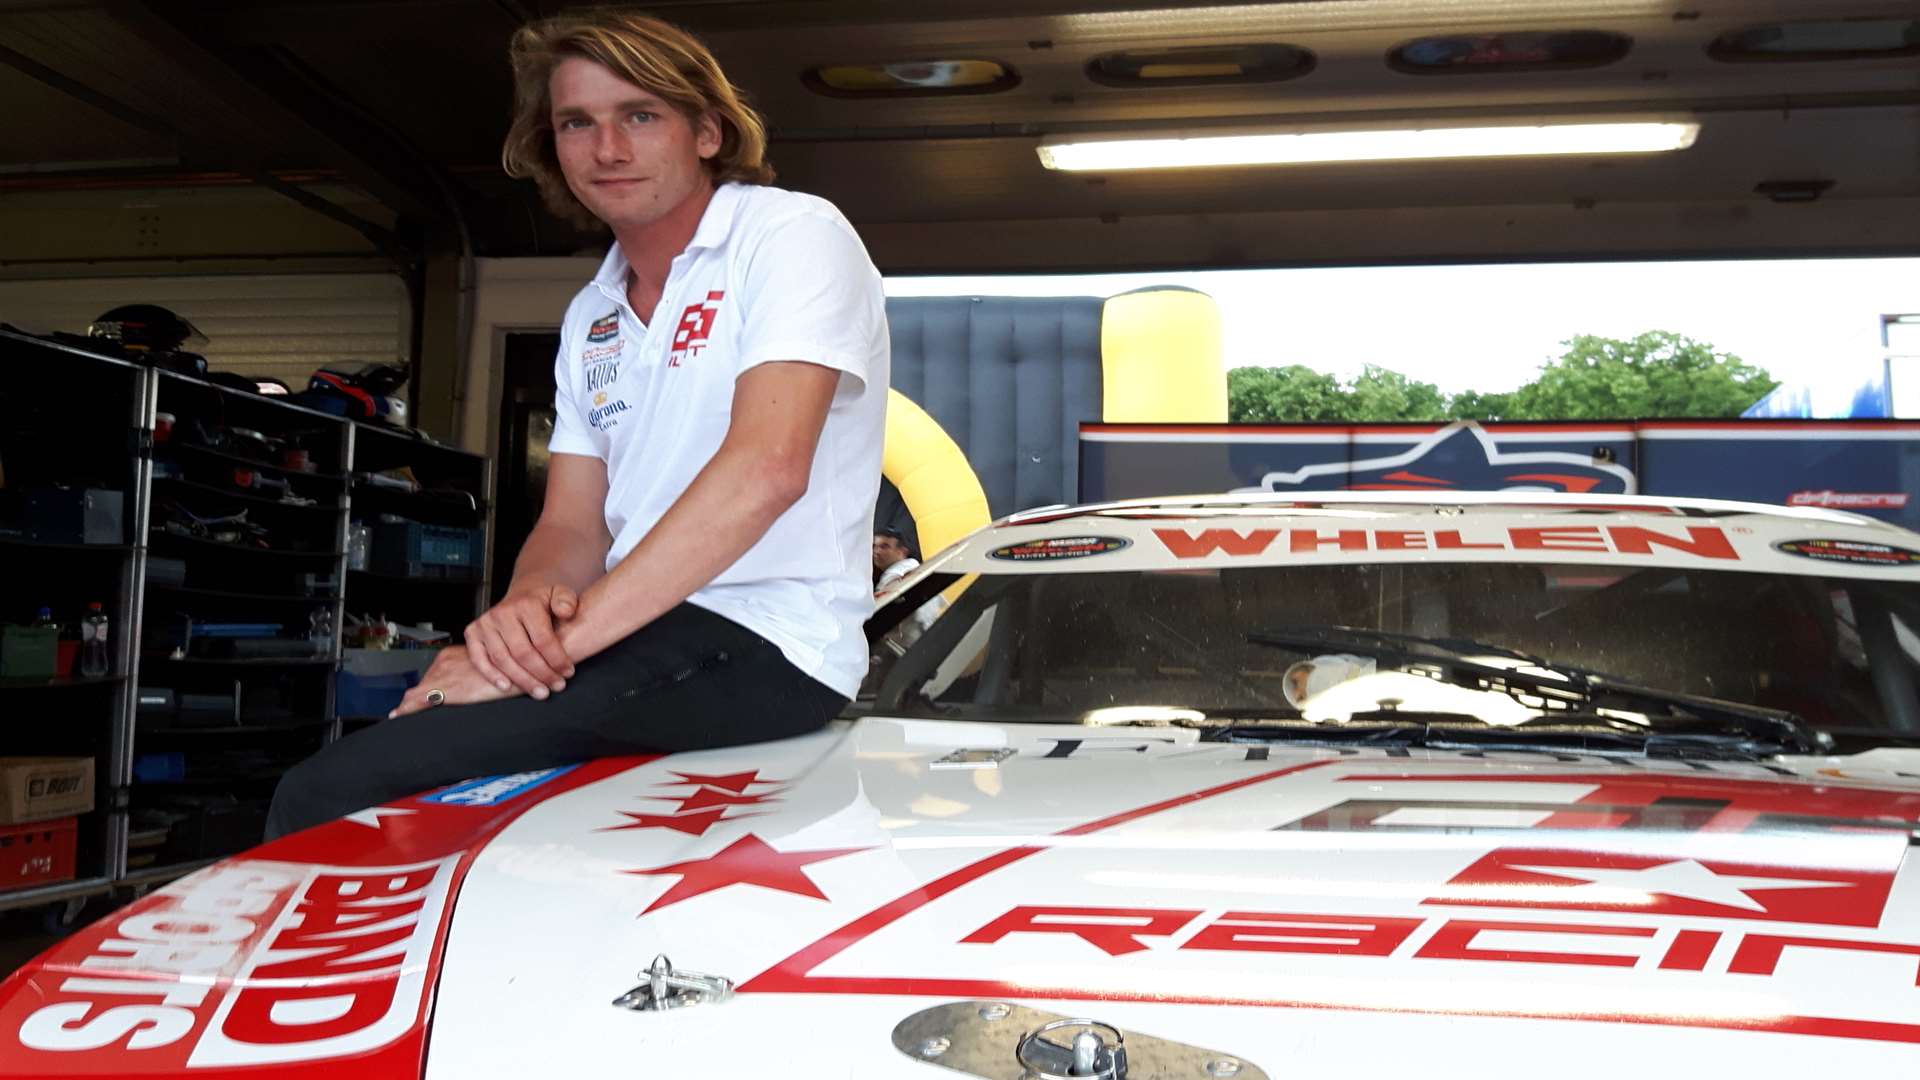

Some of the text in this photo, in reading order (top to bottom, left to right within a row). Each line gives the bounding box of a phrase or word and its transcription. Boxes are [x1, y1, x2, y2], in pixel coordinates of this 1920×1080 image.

[588, 400, 629, 427] Corona
[1151, 527, 1741, 561] WHELEN
[222, 862, 441, 1044] BAND
